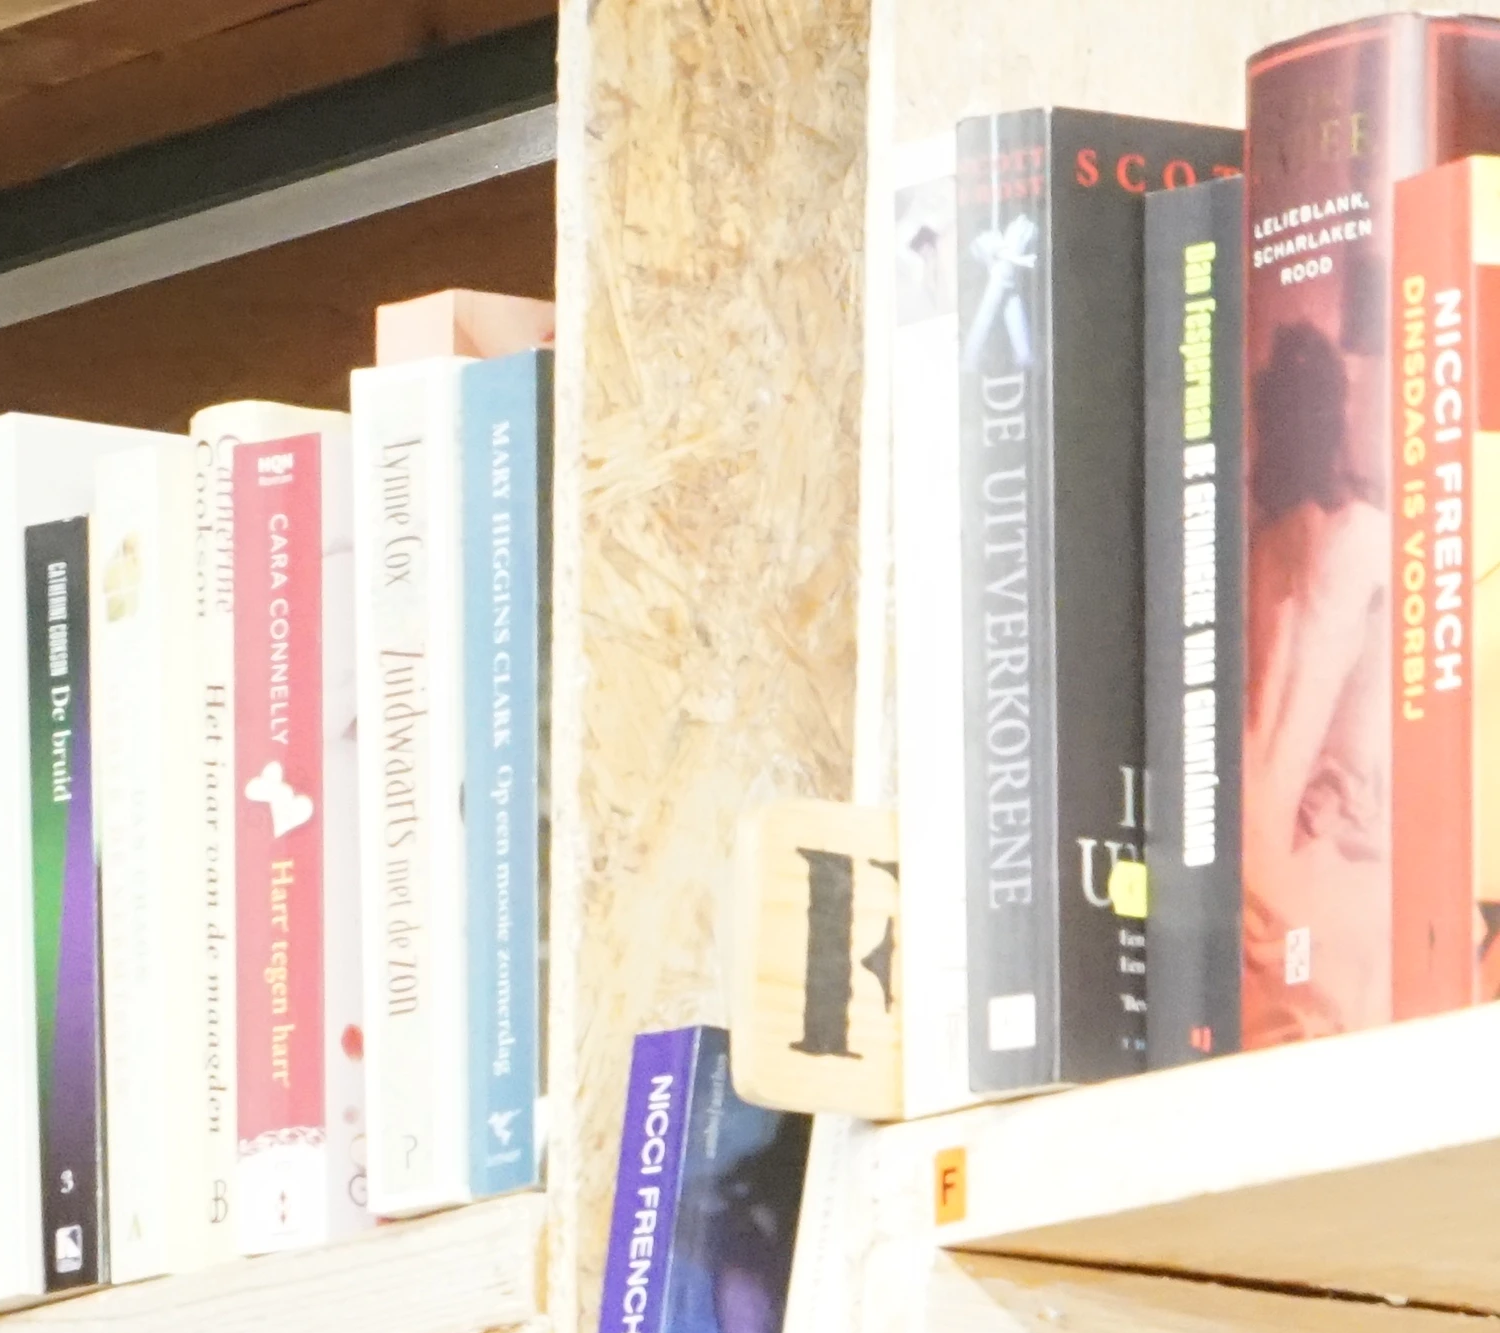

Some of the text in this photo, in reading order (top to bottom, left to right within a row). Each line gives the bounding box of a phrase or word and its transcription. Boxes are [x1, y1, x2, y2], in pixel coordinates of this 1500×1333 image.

[1254, 220, 1372, 268] SCHARLAKEN
[1280, 257, 1333, 286] ROOD
[1404, 277, 1426, 467] DINSDAG
[1434, 290, 1463, 442] NICCI
[490, 420, 511, 498] MARY
[490, 512, 513, 644] HIGGINS
[1403, 481, 1425, 720] IS VOORBIJ
[1434, 464, 1461, 691] FRENCH
[267, 513, 290, 748] CARA CONNELLY
[982, 375, 1032, 909] DE UITVERKORENE
[492, 649, 513, 748] CLARK
[495, 764, 515, 807] Op
[497, 815, 515, 854] een
[641, 1074, 673, 1175] NICCI
[941, 1170, 955, 1205] F
